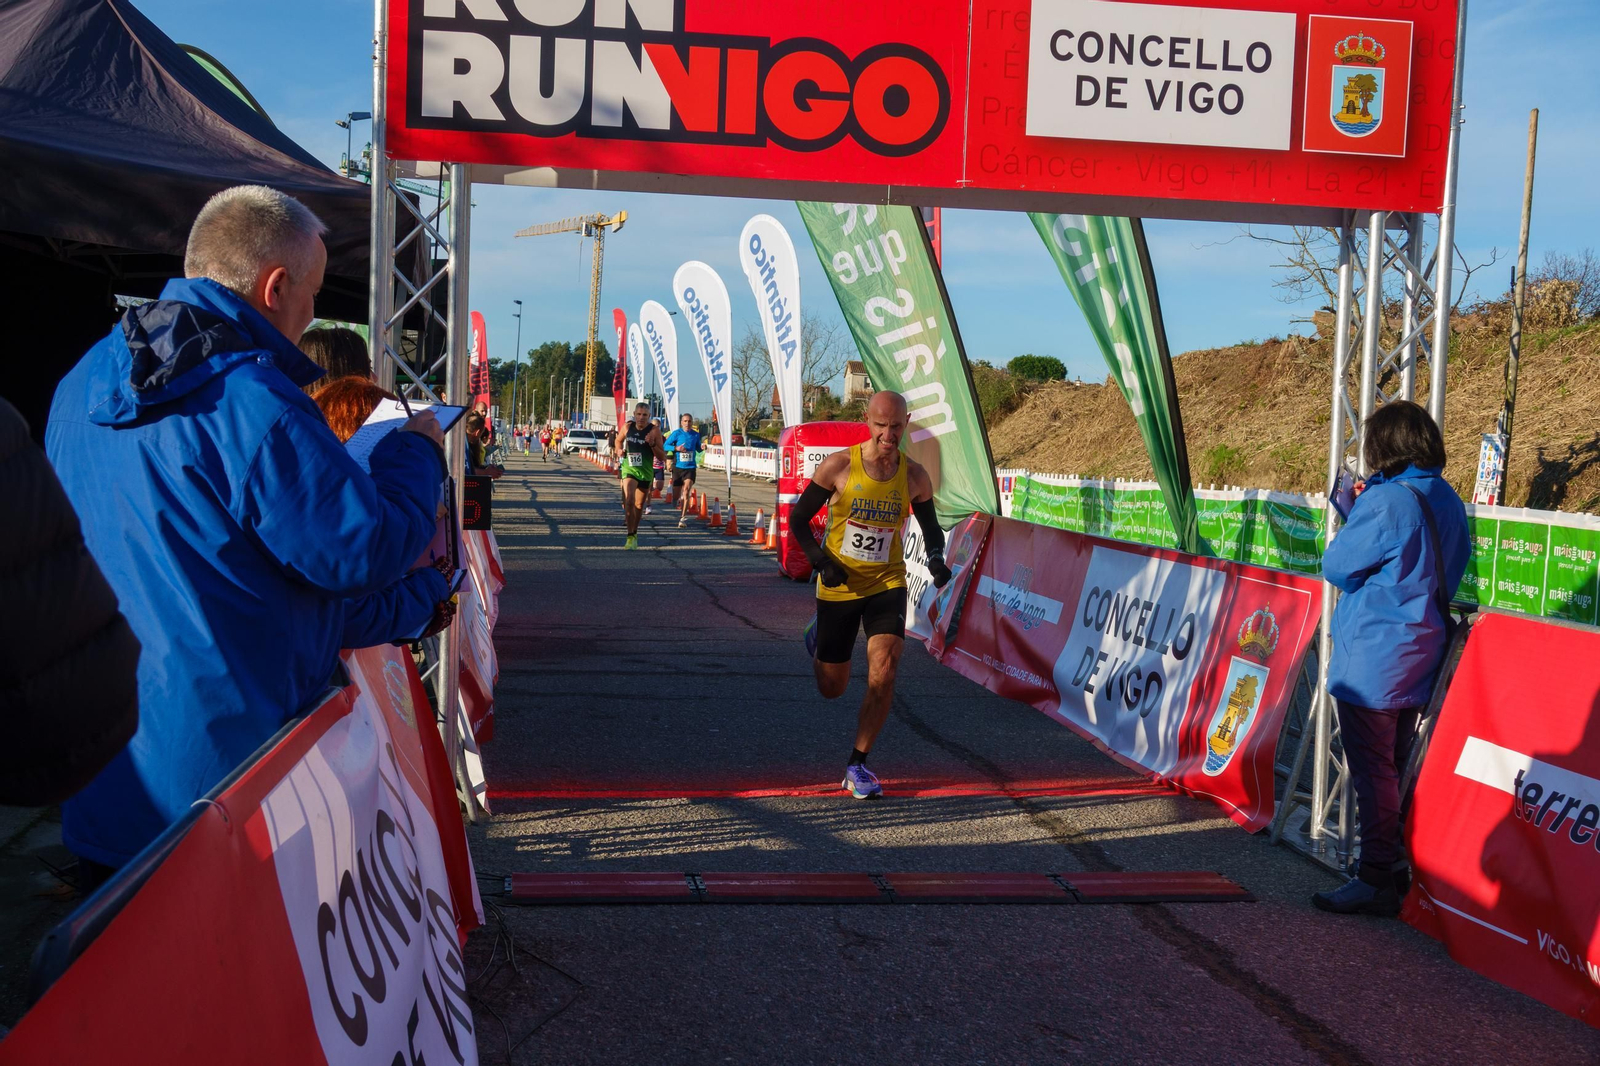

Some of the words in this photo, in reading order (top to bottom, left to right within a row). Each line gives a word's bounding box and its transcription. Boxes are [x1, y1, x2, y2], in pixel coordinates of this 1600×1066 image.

[1049, 29, 1273, 74] CONCELLO
[1075, 76, 1128, 109] DE
[1145, 79, 1245, 116] VIGO
[979, 143, 1102, 181] Cáncer
[1134, 152, 1209, 193] Vigo
[1305, 164, 1343, 194] La
[1355, 164, 1390, 196] 21
[851, 498, 903, 512] ATHLETICS
[851, 510, 867, 520] SAN
[851, 532, 885, 552] 321
[1501, 536, 1519, 552] máis
[1524, 541, 1543, 556] auga
[1553, 543, 1572, 559] máis
[1577, 548, 1596, 564] auga
[1498, 578, 1515, 593] máis
[1520, 583, 1539, 599] auga
[1549, 587, 1568, 602] máis
[1573, 592, 1592, 608] auga
[1003, 593, 1021, 618] de
[1014, 602, 1046, 631] xogo
[1083, 586, 1196, 661] CONCELLO
[1005, 664, 1028, 681] CIDADE
[1026, 672, 1043, 687] PARA
[1071, 645, 1109, 695] DE
[1105, 657, 1163, 719] VIGO
